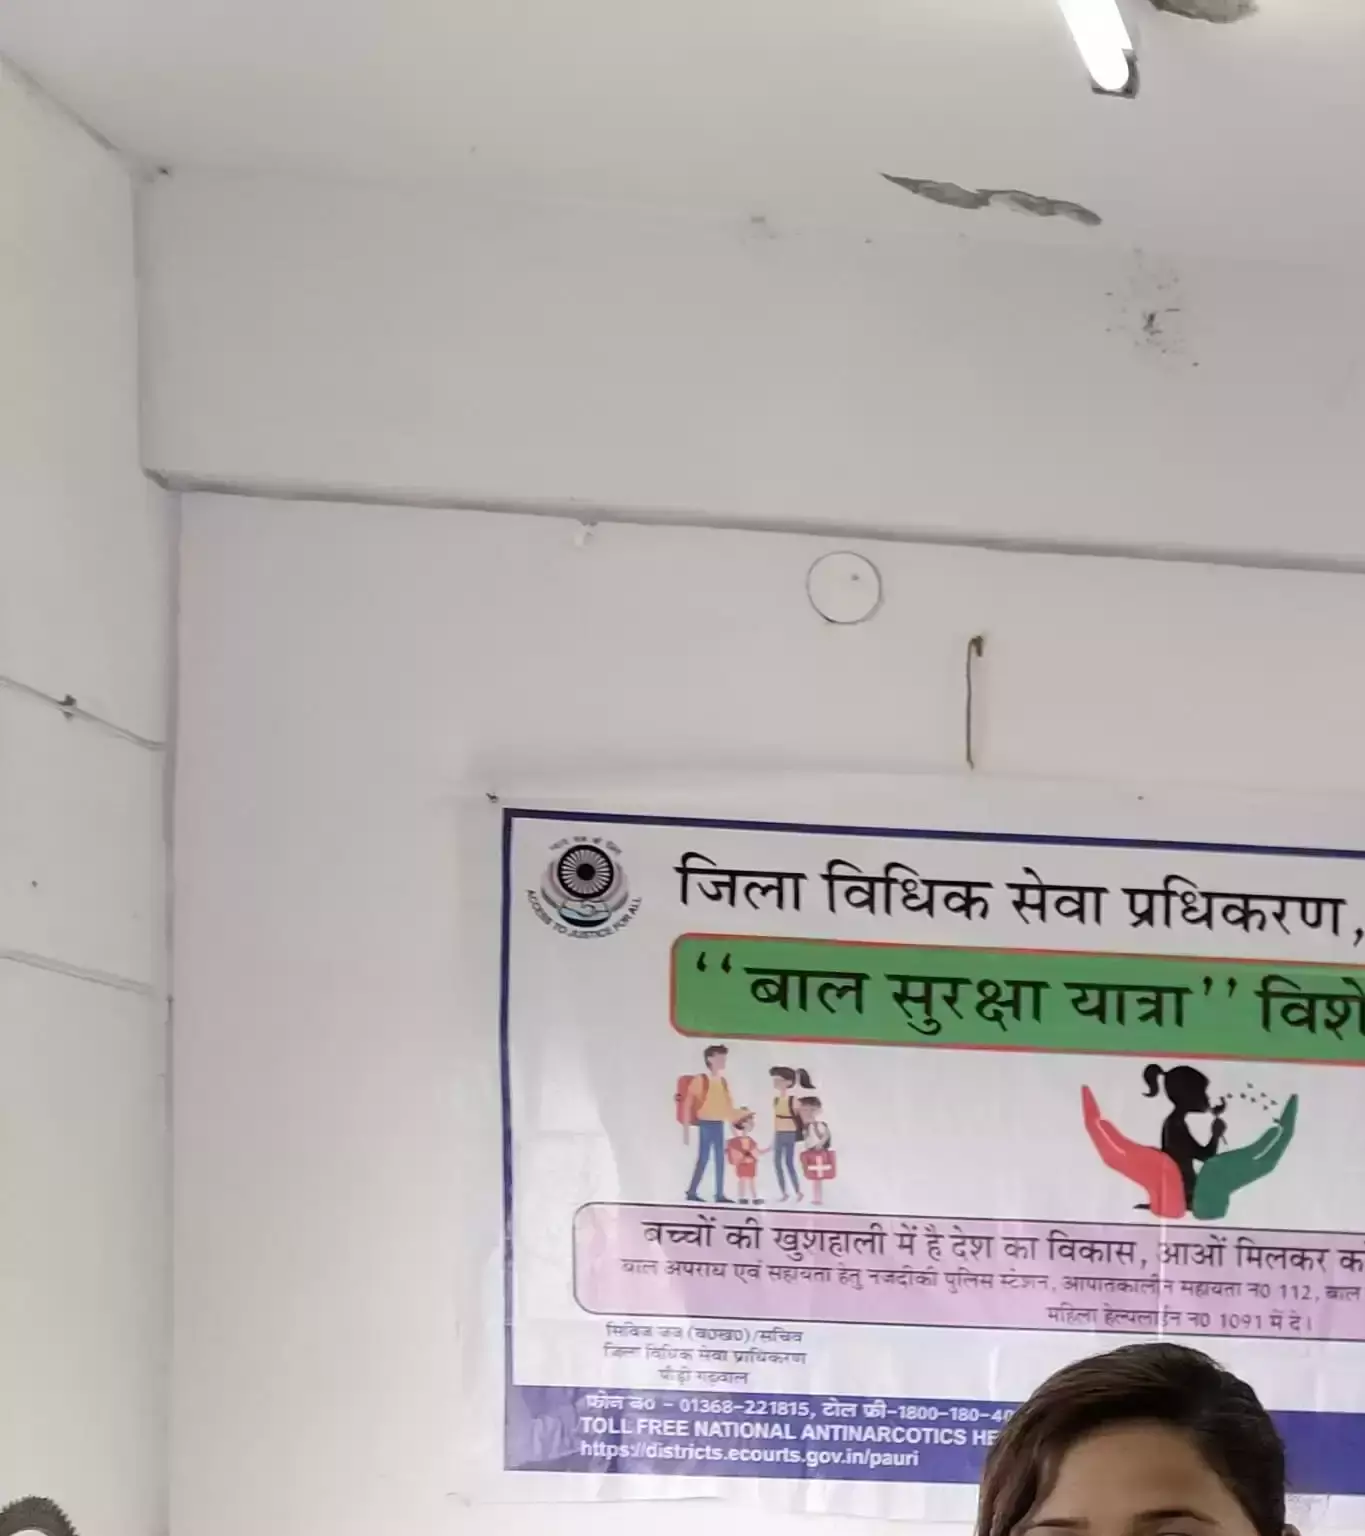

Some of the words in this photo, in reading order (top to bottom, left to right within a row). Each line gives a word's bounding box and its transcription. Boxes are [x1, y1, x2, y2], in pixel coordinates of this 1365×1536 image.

[675, 853, 806, 911] जिला
[822, 859, 992, 920] विधिक
[1006, 868, 1107, 926] सेवा
[885, 973, 1051, 1035] सुरक्षा
[641, 1214, 716, 1247] बच्चों
[724, 1217, 763, 1250] की
[770, 1221, 888, 1261] खुशहाली
[895, 1223, 917, 1256] में
[924, 1224, 944, 1261] है
[949, 1224, 994, 1263] देश
[1001, 1236, 1038, 1262] का
[1046, 1229, 1147, 1269] विकास,
[1234, 1236, 1330, 1273] मिलकर
[1219, 1312, 1263, 1331] 1091
[821, 1397, 858, 1419] टोल
[580, 1416, 633, 1435] TOLL
[636, 1418, 690, 1437] FREE
[693, 1421, 797, 1441] NATIONAL
[801, 1423, 967, 1446] ANTINARCOTICS
[580, 1439, 920, 1470] https://districts.ecourts.gov.in/pauri
